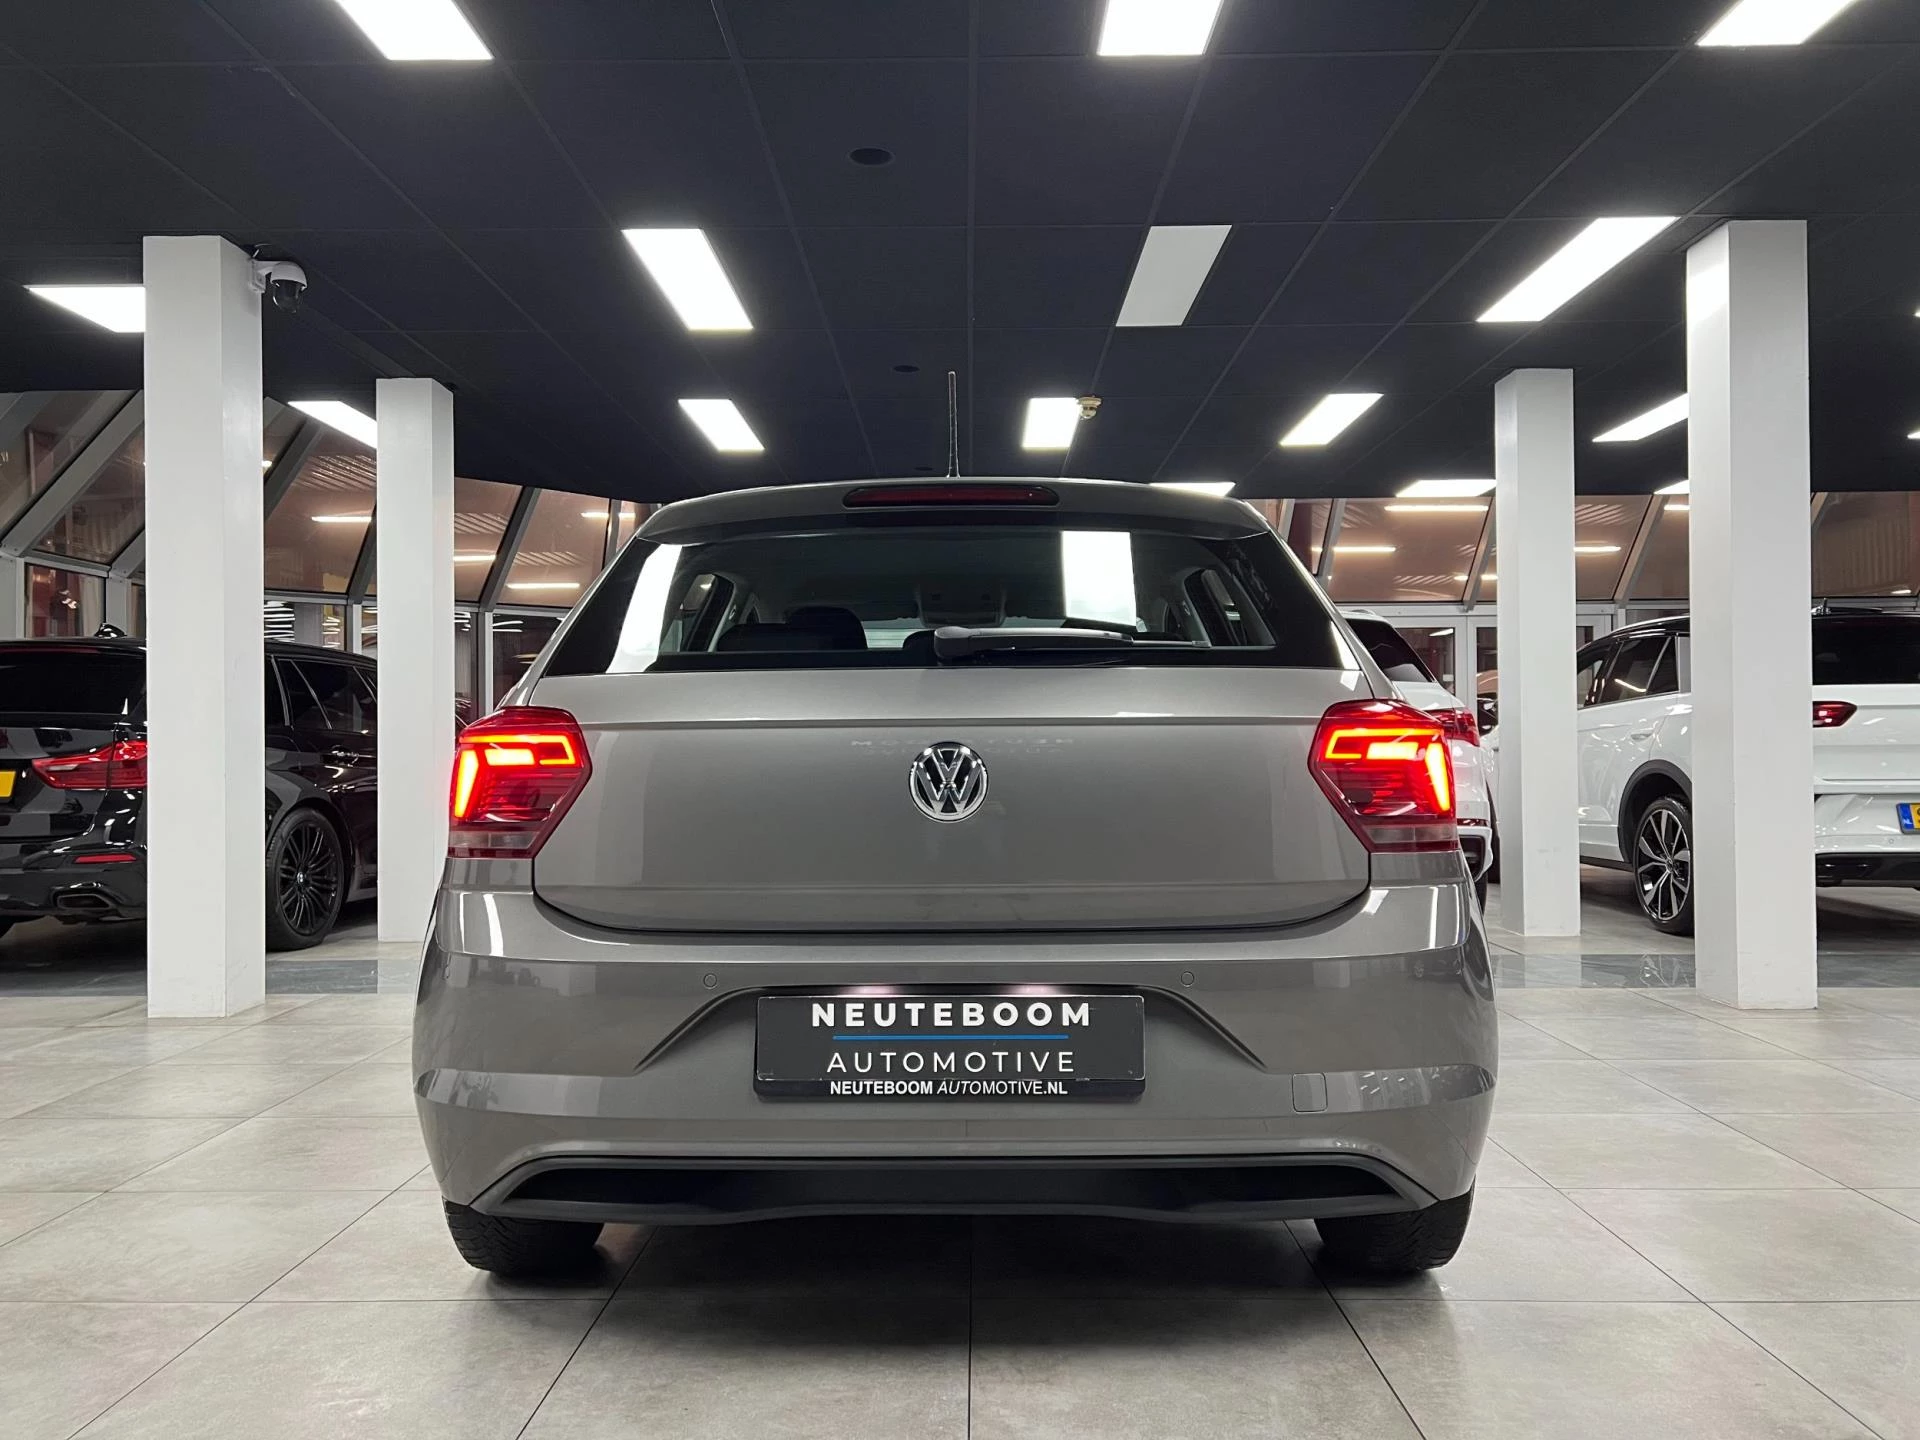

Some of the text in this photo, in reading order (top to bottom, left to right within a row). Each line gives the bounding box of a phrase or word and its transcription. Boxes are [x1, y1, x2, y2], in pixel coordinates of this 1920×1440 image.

[812, 1002, 1090, 1027] NEUTEBOOM
[826, 1051, 1074, 1073] AUTOMOTIVE
[830, 1080, 1068, 1095] NEUTEBOOM AUTOMOTIVE.NL
